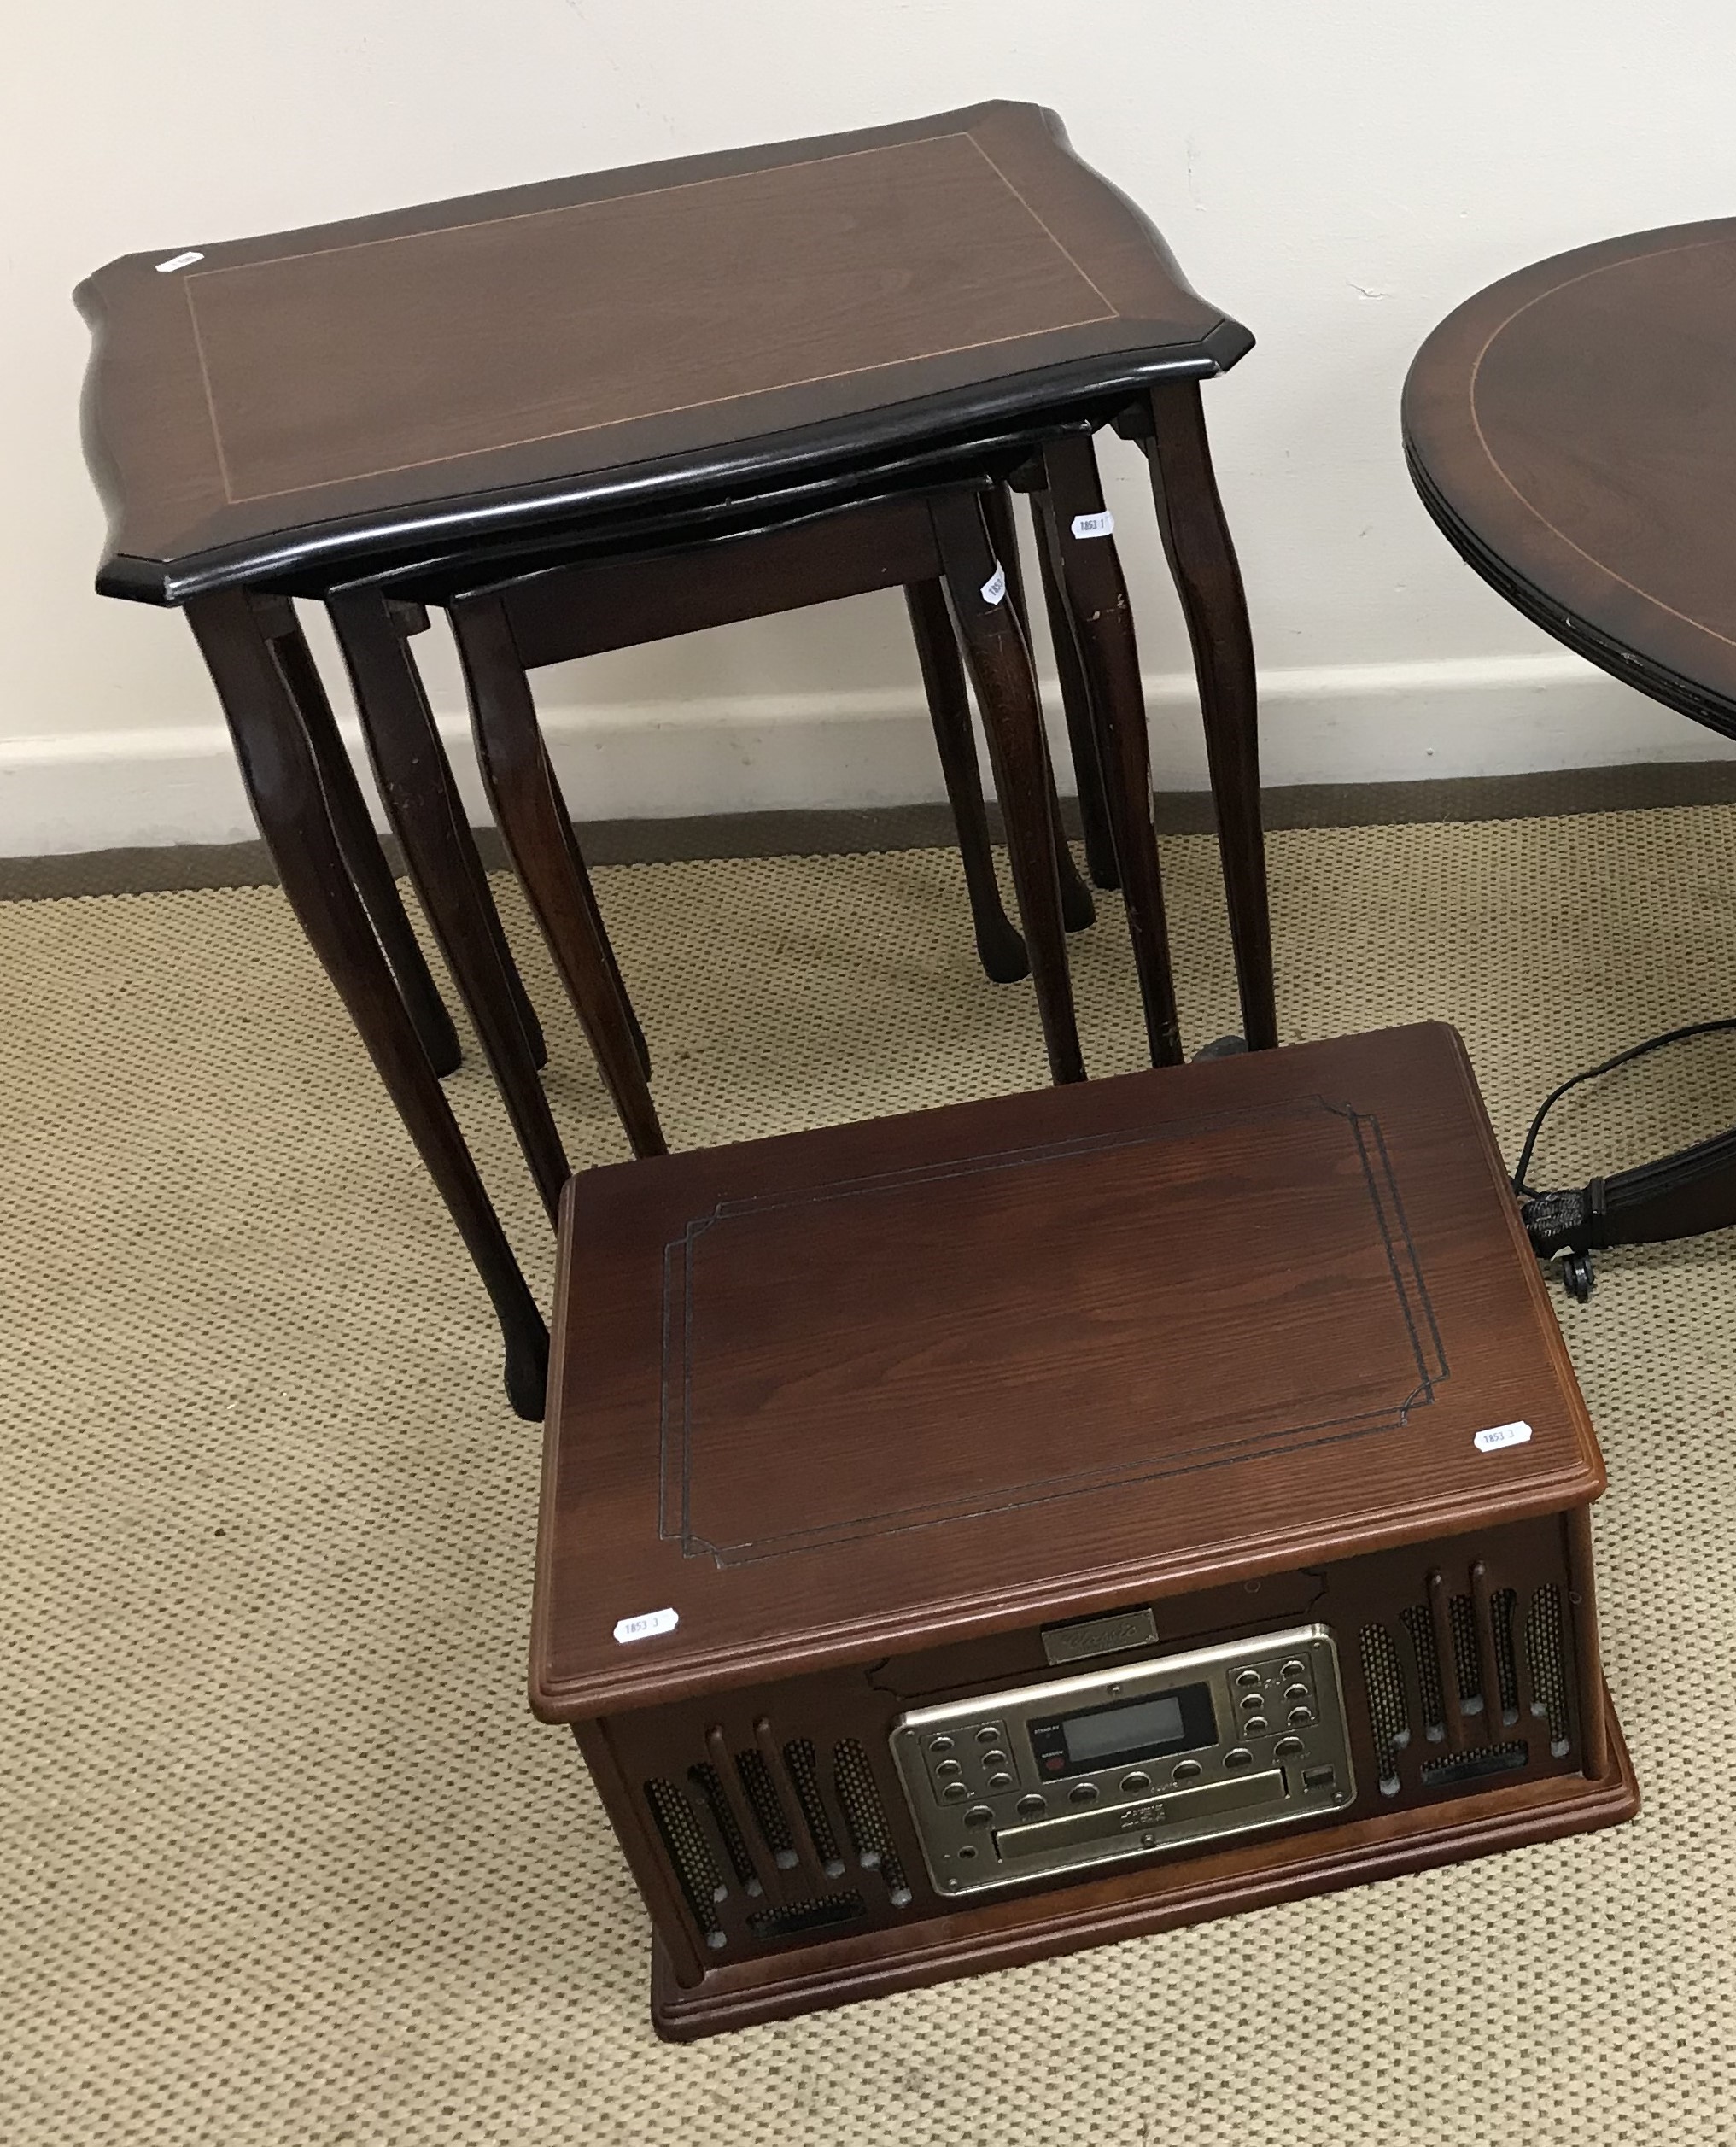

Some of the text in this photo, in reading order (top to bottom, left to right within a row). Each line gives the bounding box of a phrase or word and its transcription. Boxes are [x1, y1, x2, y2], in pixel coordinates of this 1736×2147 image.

[1080, 520, 1097, 531] 1853
[1482, 1429, 1515, 1444] 1853 3
[624, 1618, 659, 1634] 1853 3
